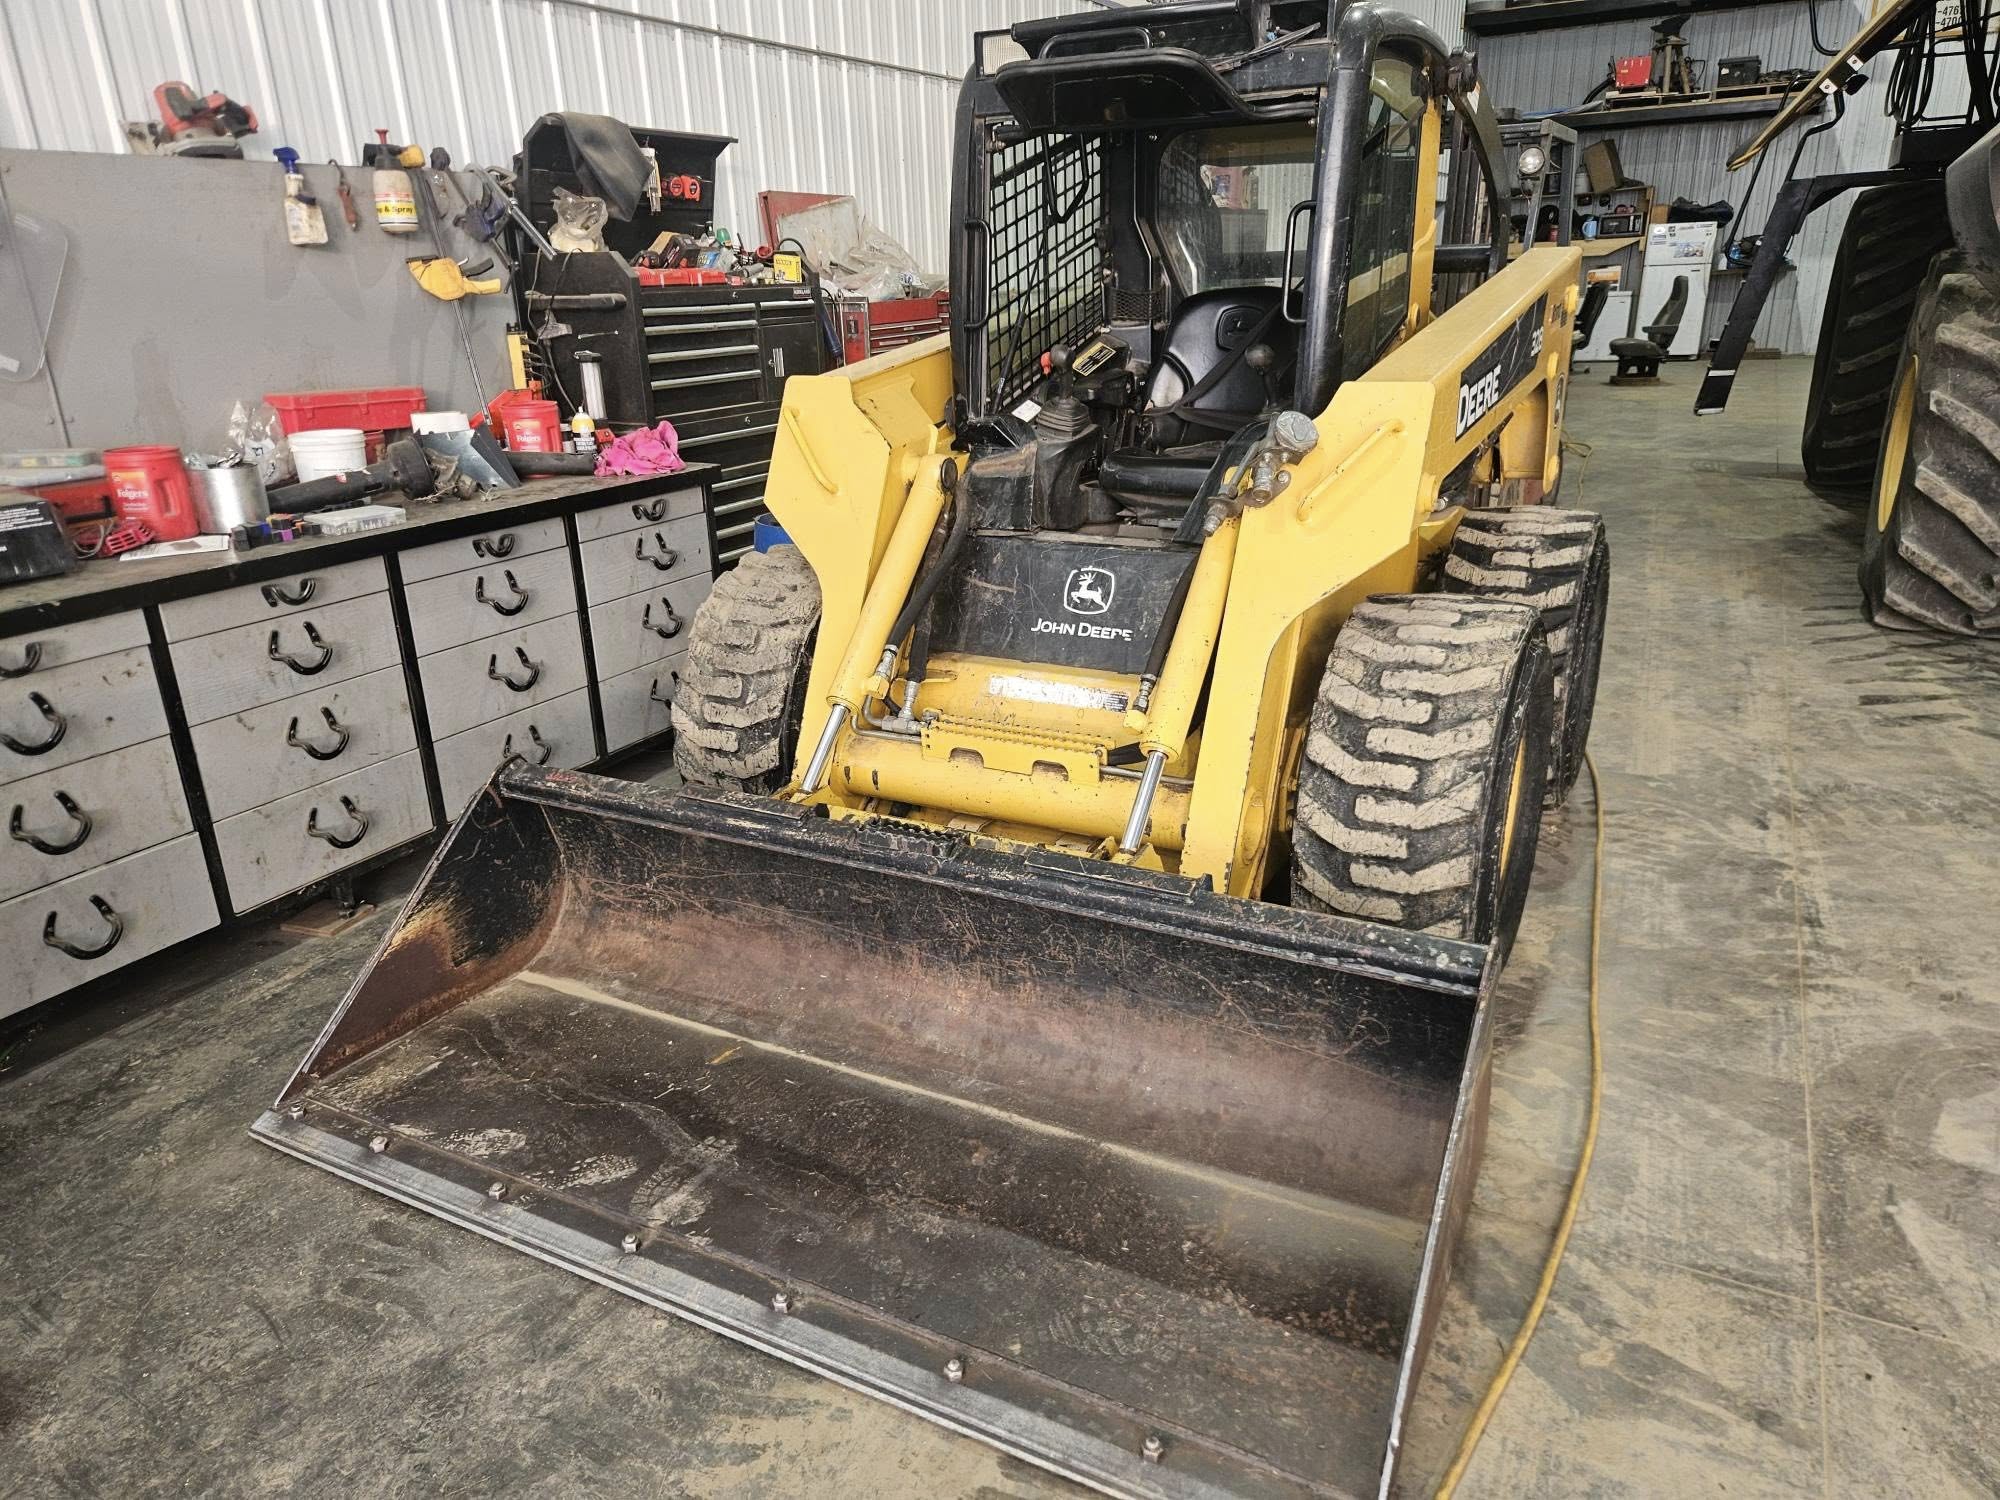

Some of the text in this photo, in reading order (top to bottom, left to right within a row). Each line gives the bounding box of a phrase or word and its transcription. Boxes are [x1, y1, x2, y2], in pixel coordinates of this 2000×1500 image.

[1937, 5, 1961, 16] -476
[1456, 364, 1501, 437] DEERE
[516, 434, 541, 444] Folgers
[117, 487, 149, 500] Folgers
[1031, 618, 1075, 636] JOHN
